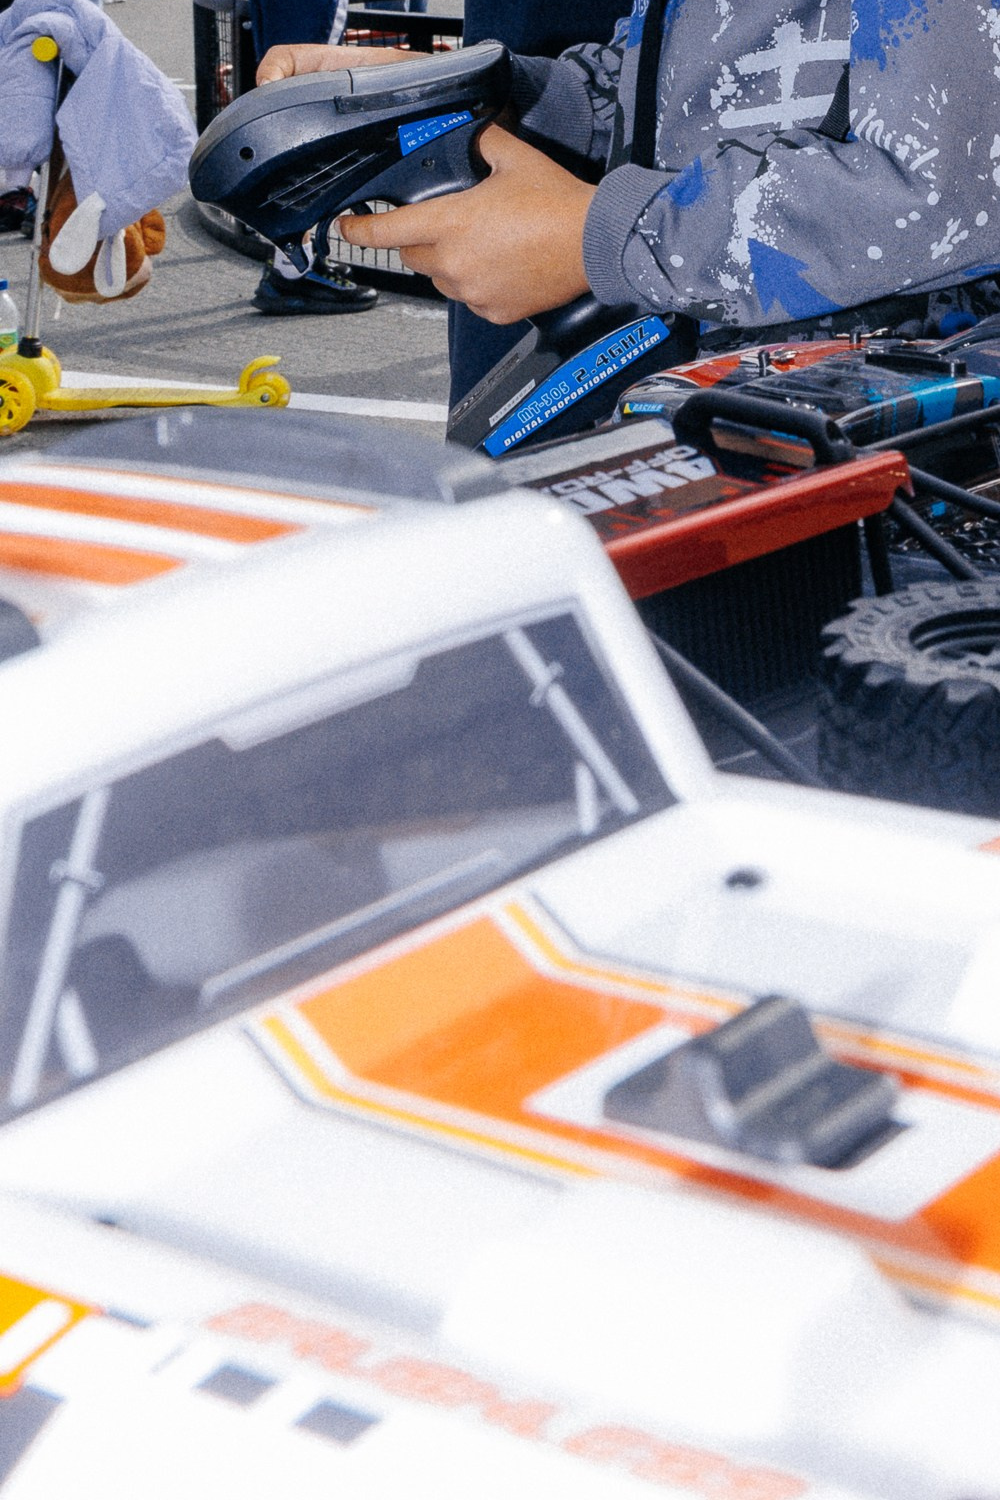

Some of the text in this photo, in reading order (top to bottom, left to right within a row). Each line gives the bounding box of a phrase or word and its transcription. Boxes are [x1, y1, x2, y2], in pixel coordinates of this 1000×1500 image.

[503, 417, 544, 447] DIGITAL
[544, 364, 619, 419] PROPORTIONAL
[619, 332, 662, 366] SYSTEM
[572, 325, 650, 383] 2.4GHZ
